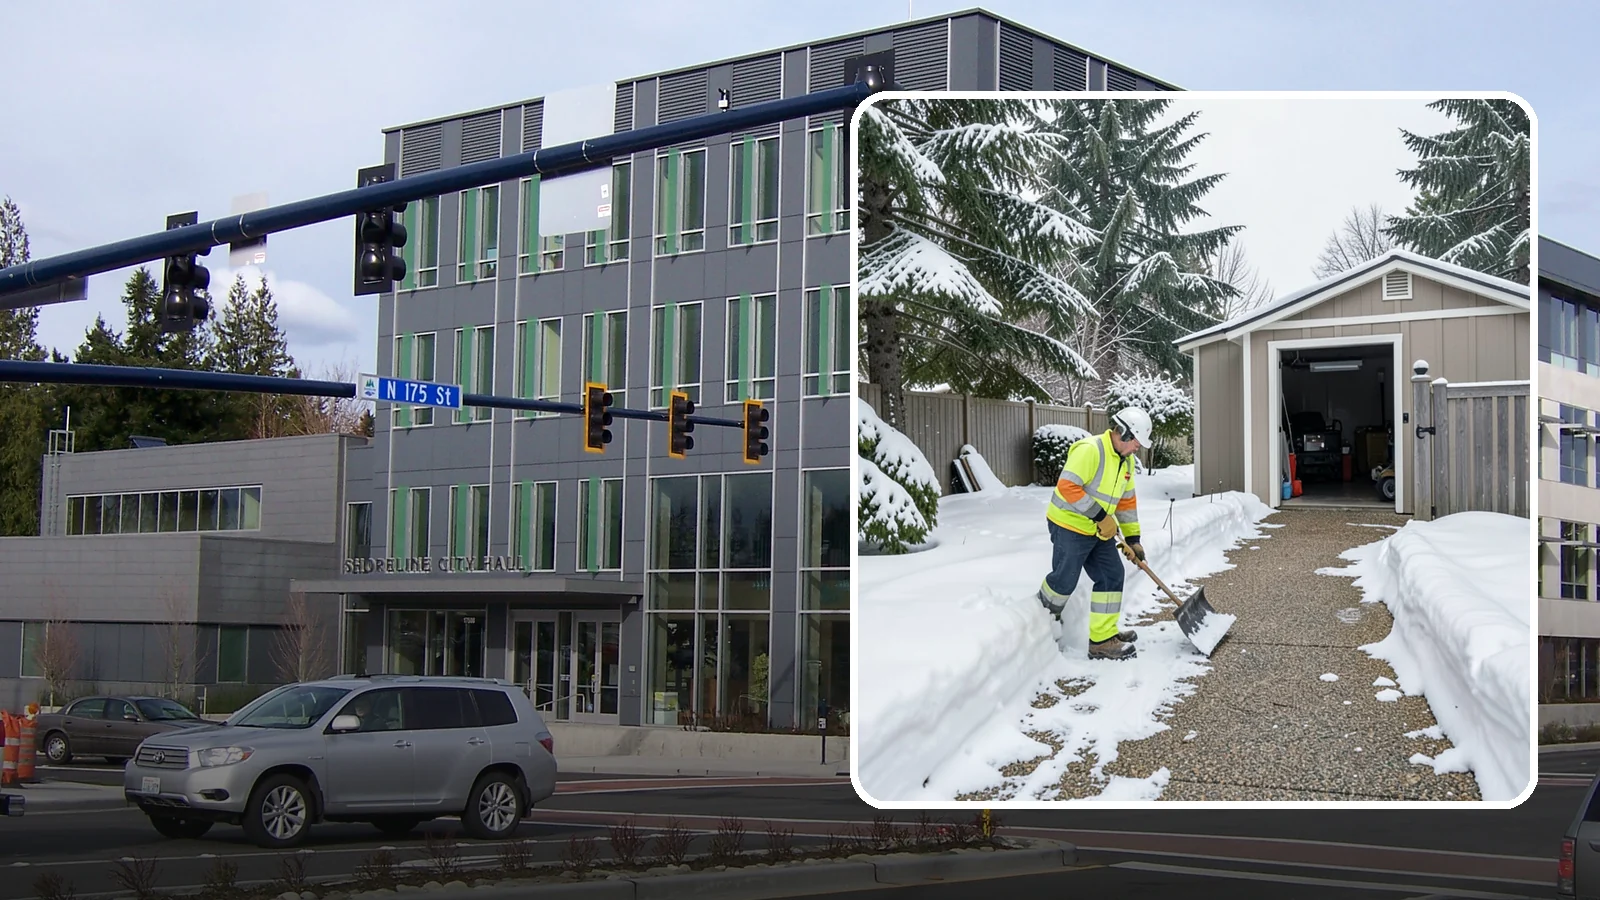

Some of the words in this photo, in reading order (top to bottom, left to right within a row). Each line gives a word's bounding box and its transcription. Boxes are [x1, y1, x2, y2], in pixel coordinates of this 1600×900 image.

[387, 380, 396, 399] N
[405, 382, 427, 403] 175
[436, 386, 451, 406] St
[344, 556, 431, 574] SHORELINE
[438, 556, 475, 572] CITY
[483, 555, 525, 571] HALL
